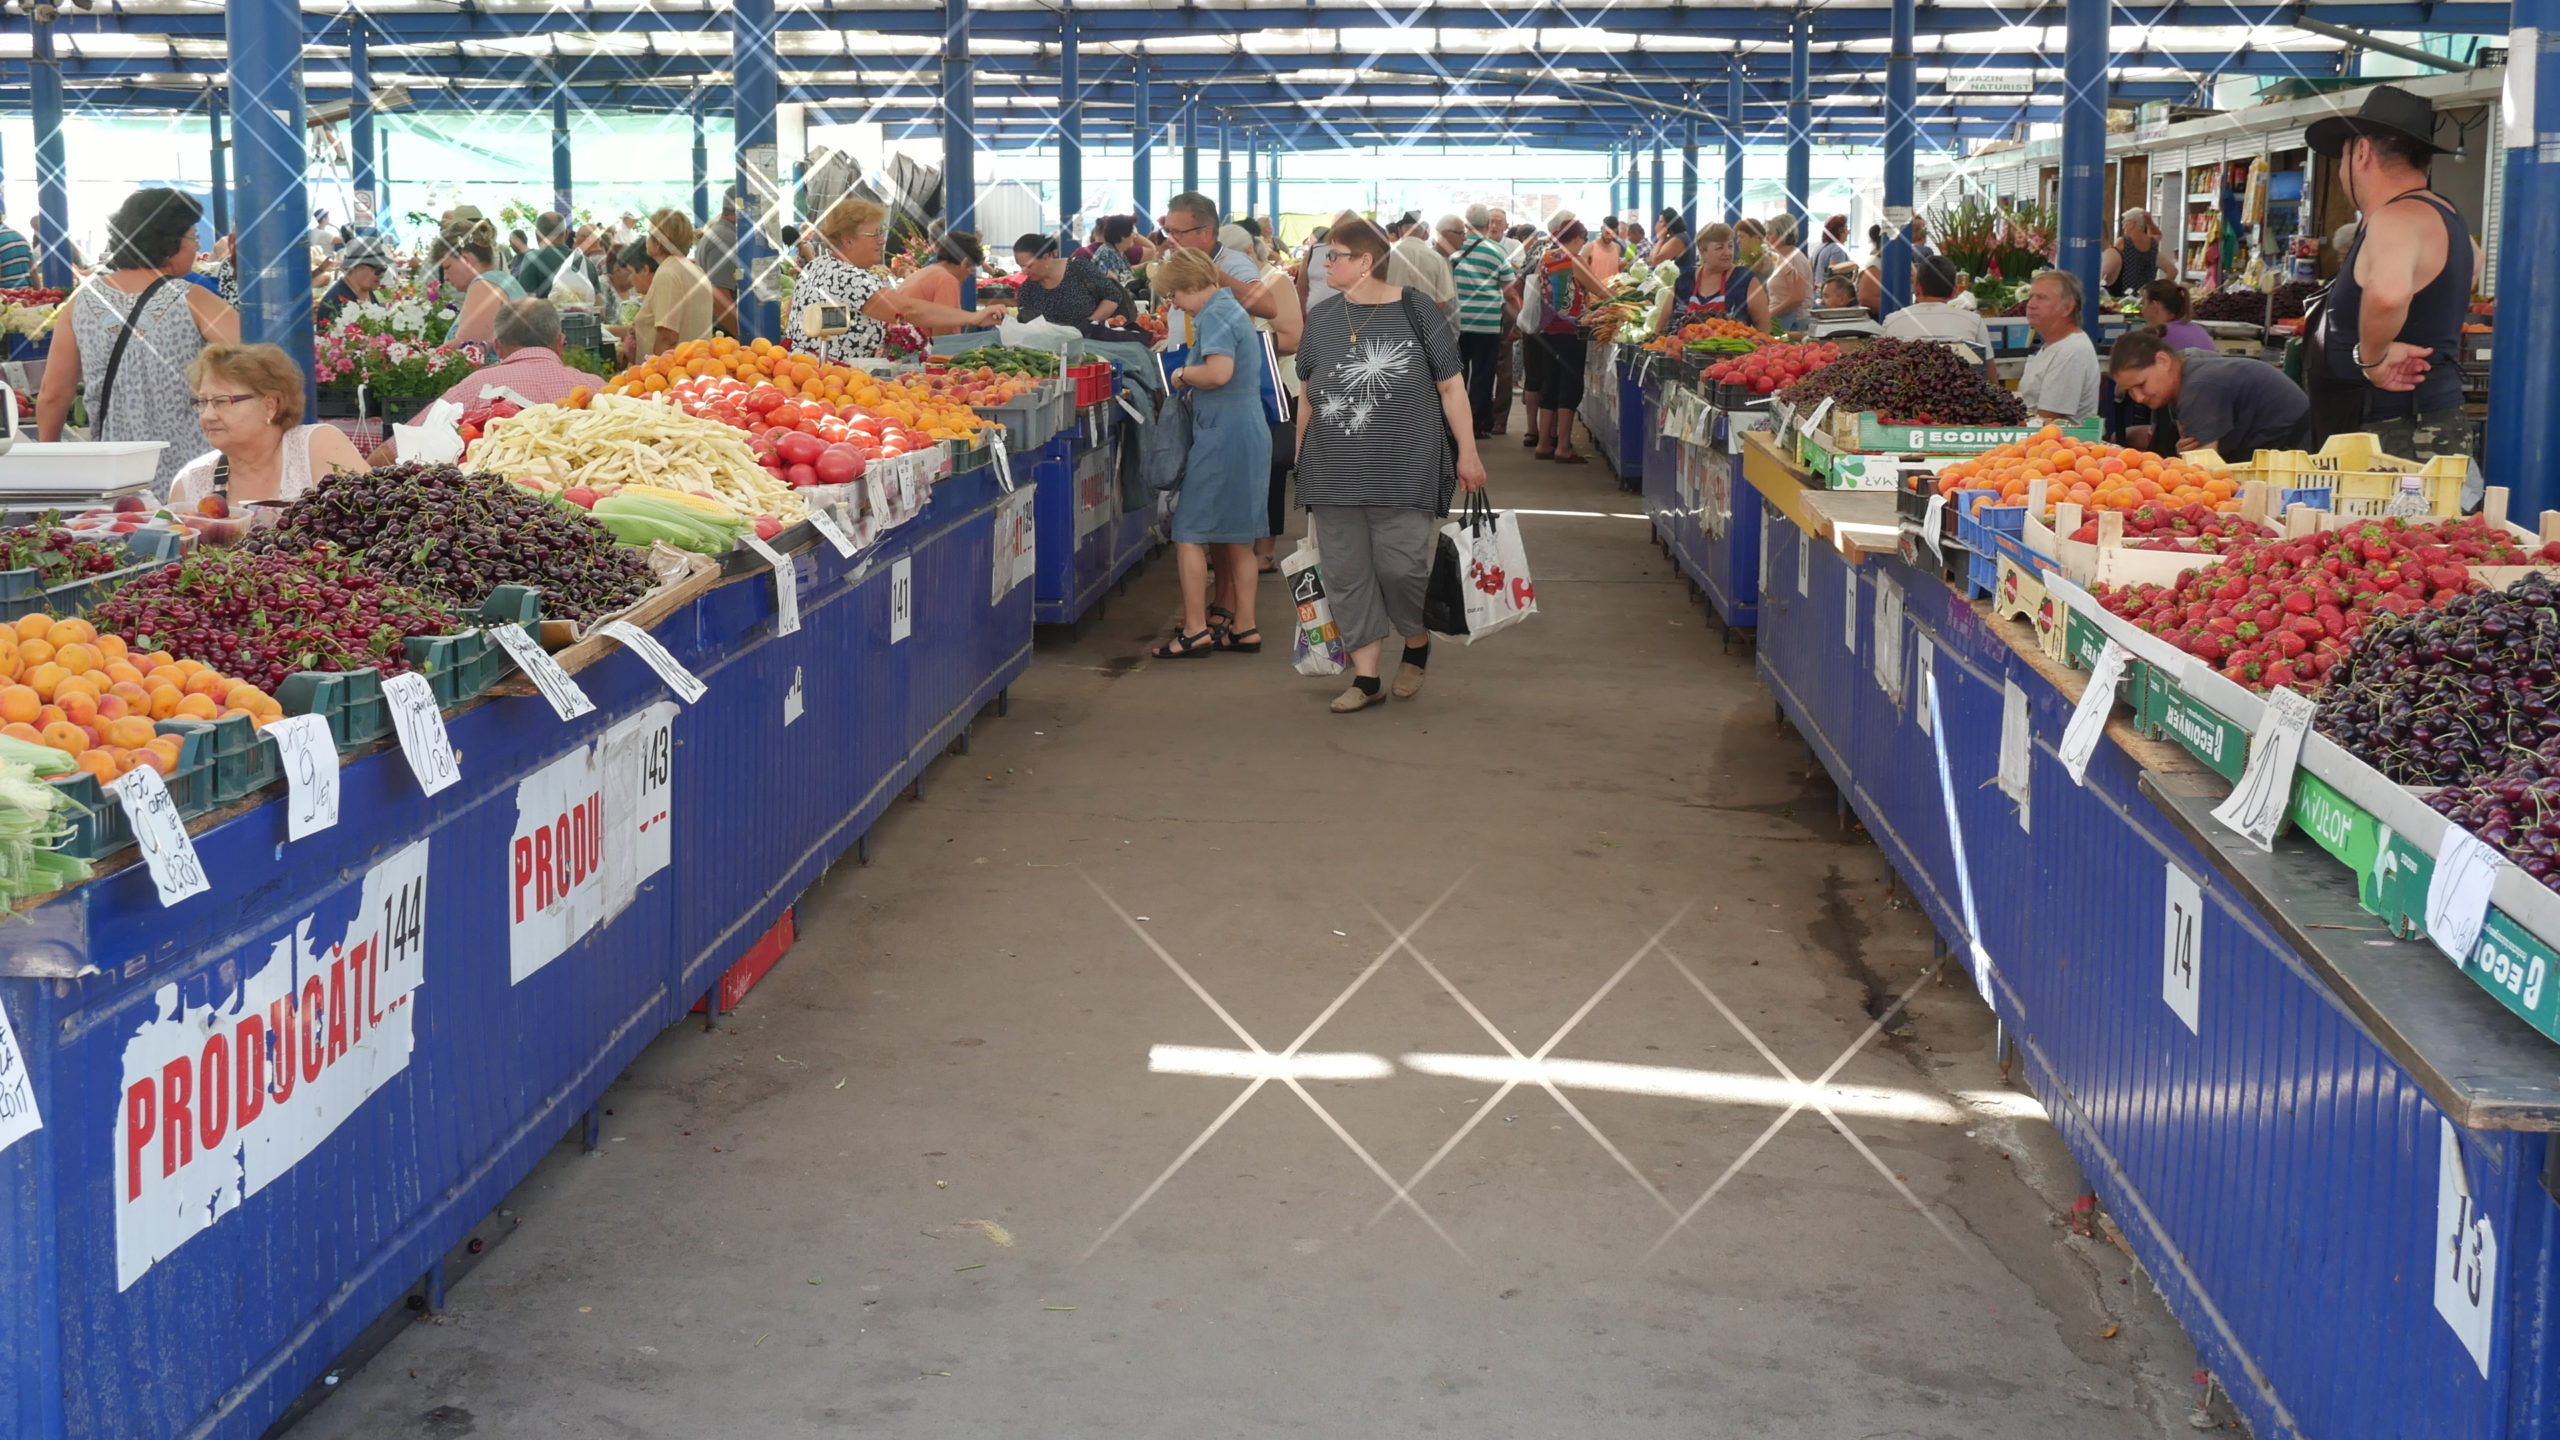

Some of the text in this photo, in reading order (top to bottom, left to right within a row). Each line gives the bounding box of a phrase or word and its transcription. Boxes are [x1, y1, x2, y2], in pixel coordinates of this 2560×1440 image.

[1970, 83, 2031, 91] NATURIST
[1929, 431, 2036, 443] ECOINVE
[893, 576, 909, 624] 141
[642, 725, 668, 797] 143
[2165, 704, 2214, 756] ECOINVER
[514, 790, 606, 924] PRODU
[384, 875, 422, 973] 144
[2173, 901, 2192, 991] 74
[2471, 937, 2525, 996] ECOI
[128, 929, 407, 1204] PRODUCĂT
